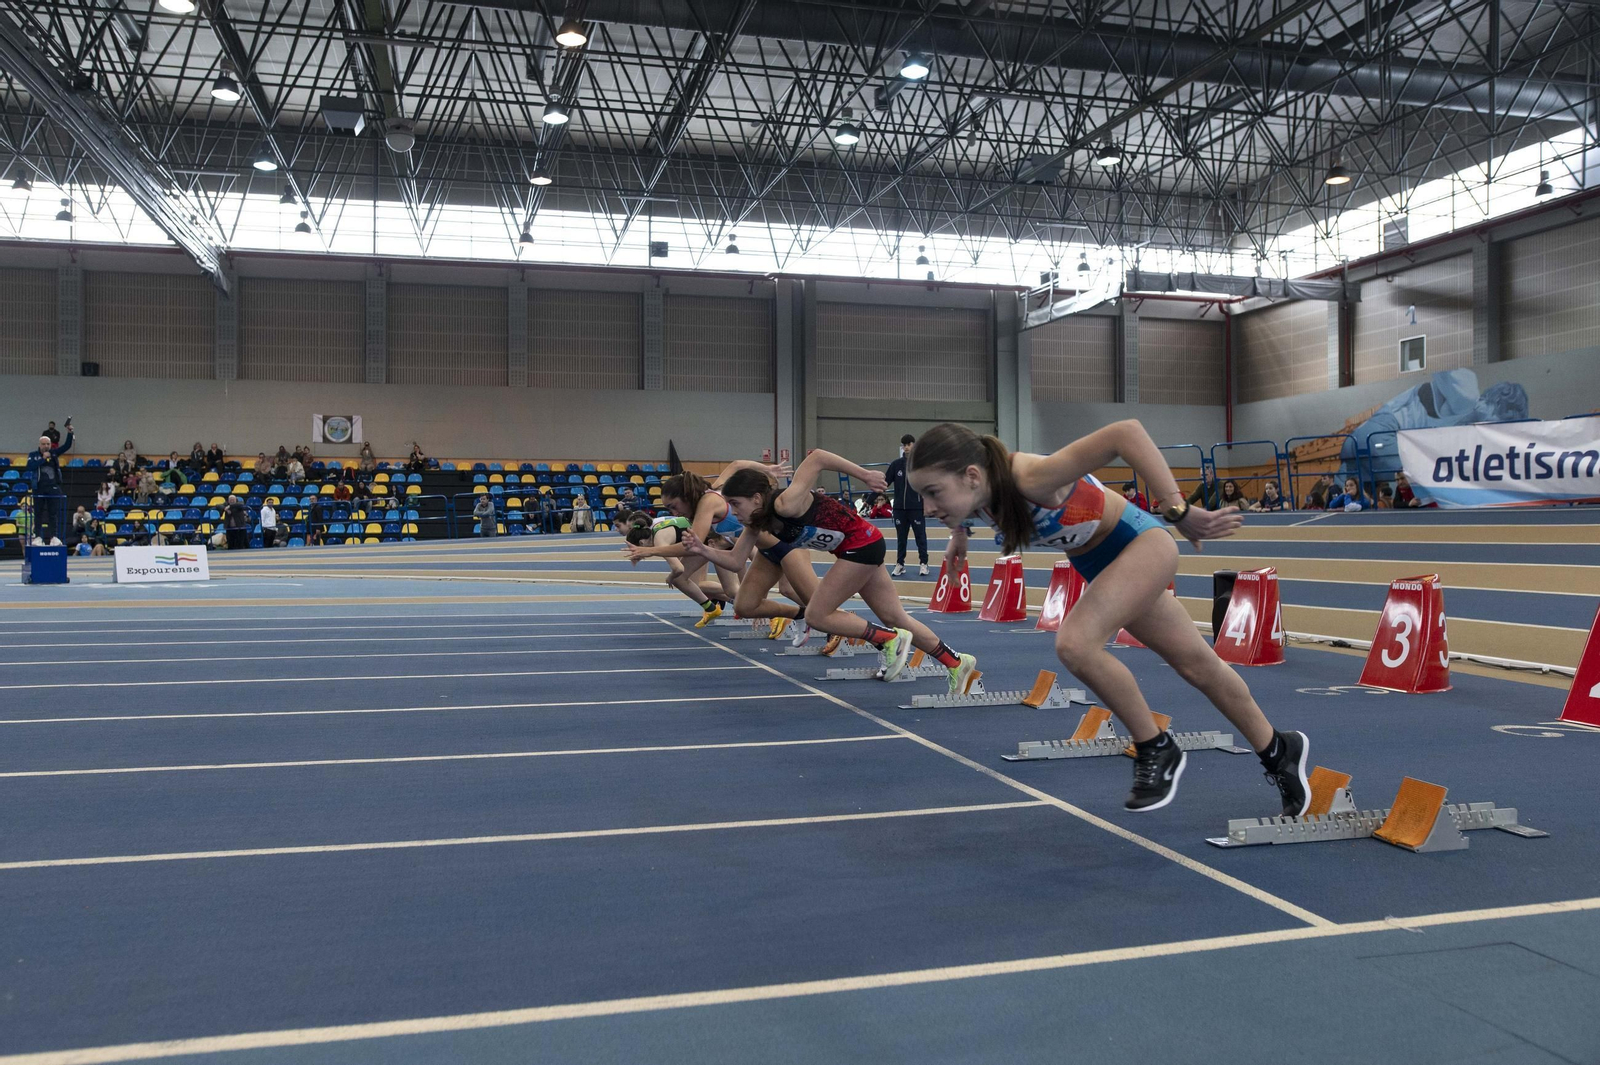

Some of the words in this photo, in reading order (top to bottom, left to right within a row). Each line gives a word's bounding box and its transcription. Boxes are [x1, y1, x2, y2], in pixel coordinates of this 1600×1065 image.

[1432, 442, 1600, 483] atletism
[126, 566, 200, 576] Expourense
[936, 573, 949, 602] 8
[960, 572, 970, 603] 8
[1237, 573, 1260, 581] MONDO
[1392, 583, 1423, 591] MONDO
[986, 579, 1003, 610] 7
[1014, 577, 1024, 610] 7
[1047, 584, 1066, 619] 6
[1225, 601, 1248, 647] 4
[1270, 600, 1283, 647] 4
[1438, 611, 1450, 669] 3
[1381, 613, 1413, 669] 3
